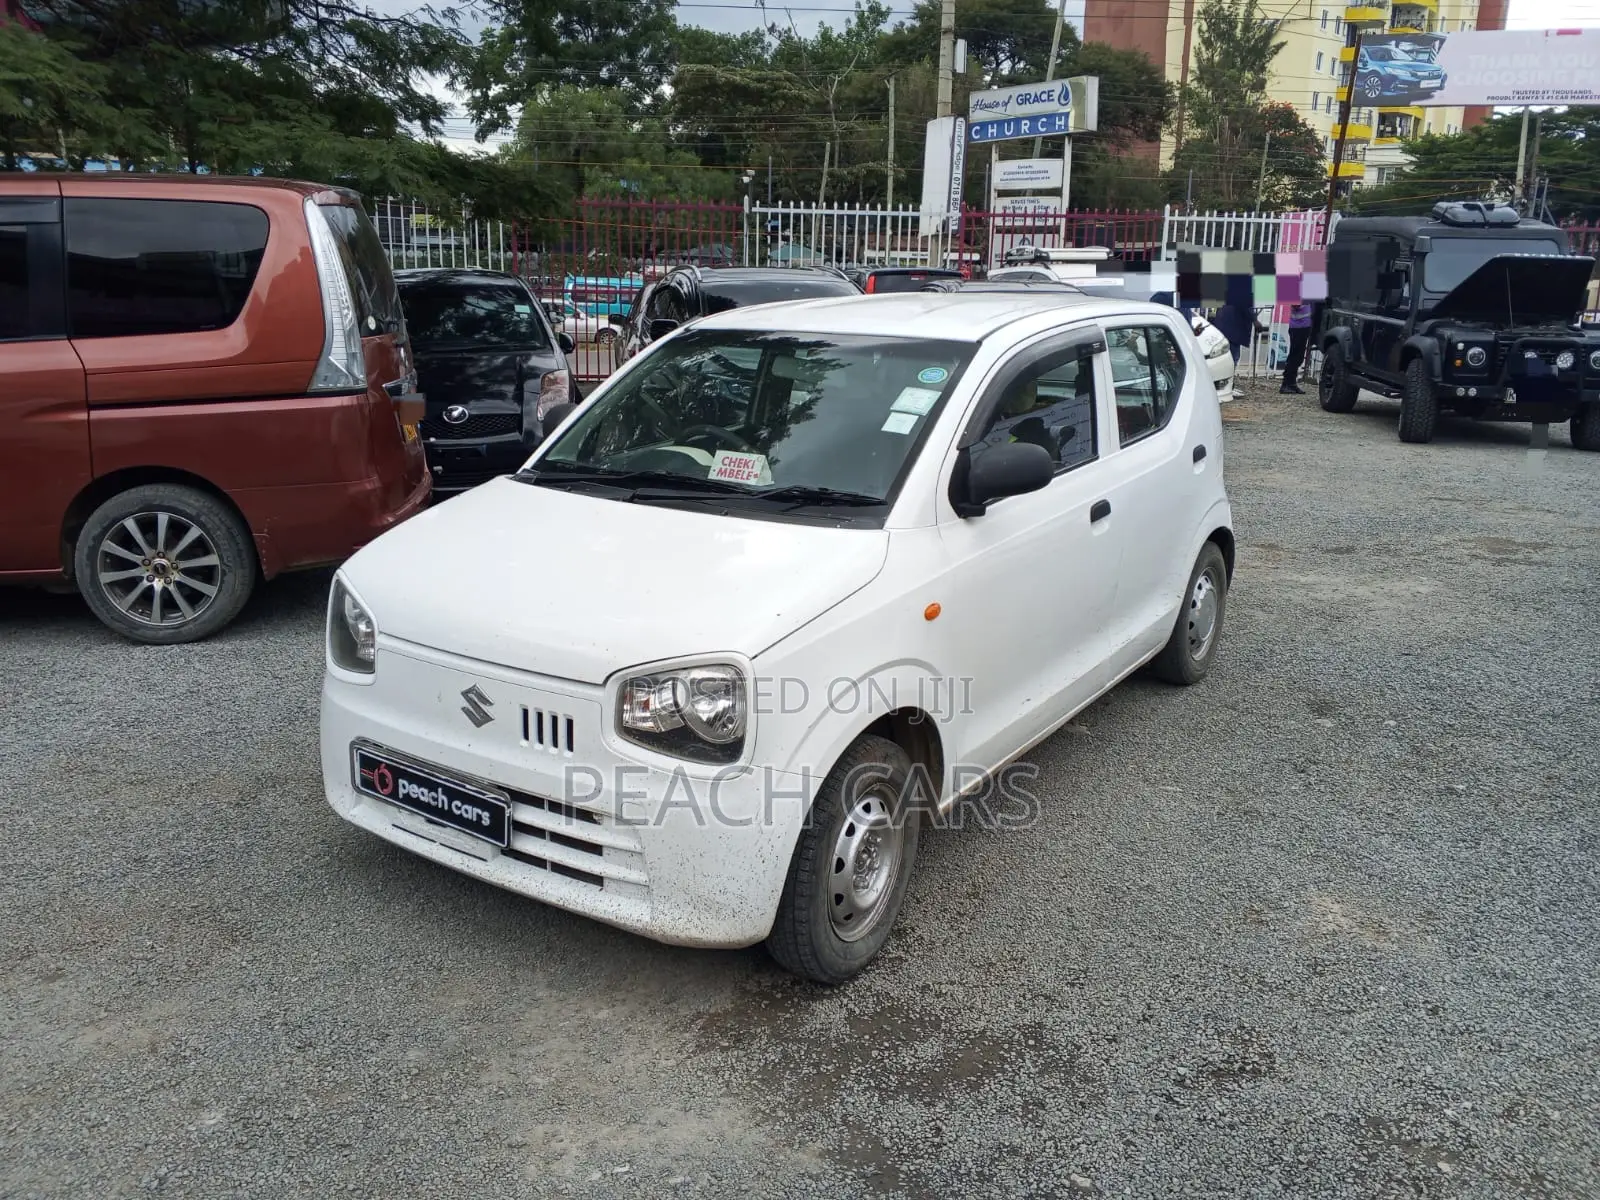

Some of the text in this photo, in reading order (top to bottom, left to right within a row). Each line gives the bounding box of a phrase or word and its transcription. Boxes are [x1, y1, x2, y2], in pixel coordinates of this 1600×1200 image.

[1468, 52, 1598, 69] THANK YOU
[1453, 69, 1571, 86] CHOOSING
[970, 89, 1055, 112] House of GRACE
[971, 116, 1065, 139] CHURCH
[721, 456, 756, 470] CHEKI
[716, 467, 754, 480] MBELE
[397, 778, 491, 827] peach cars
